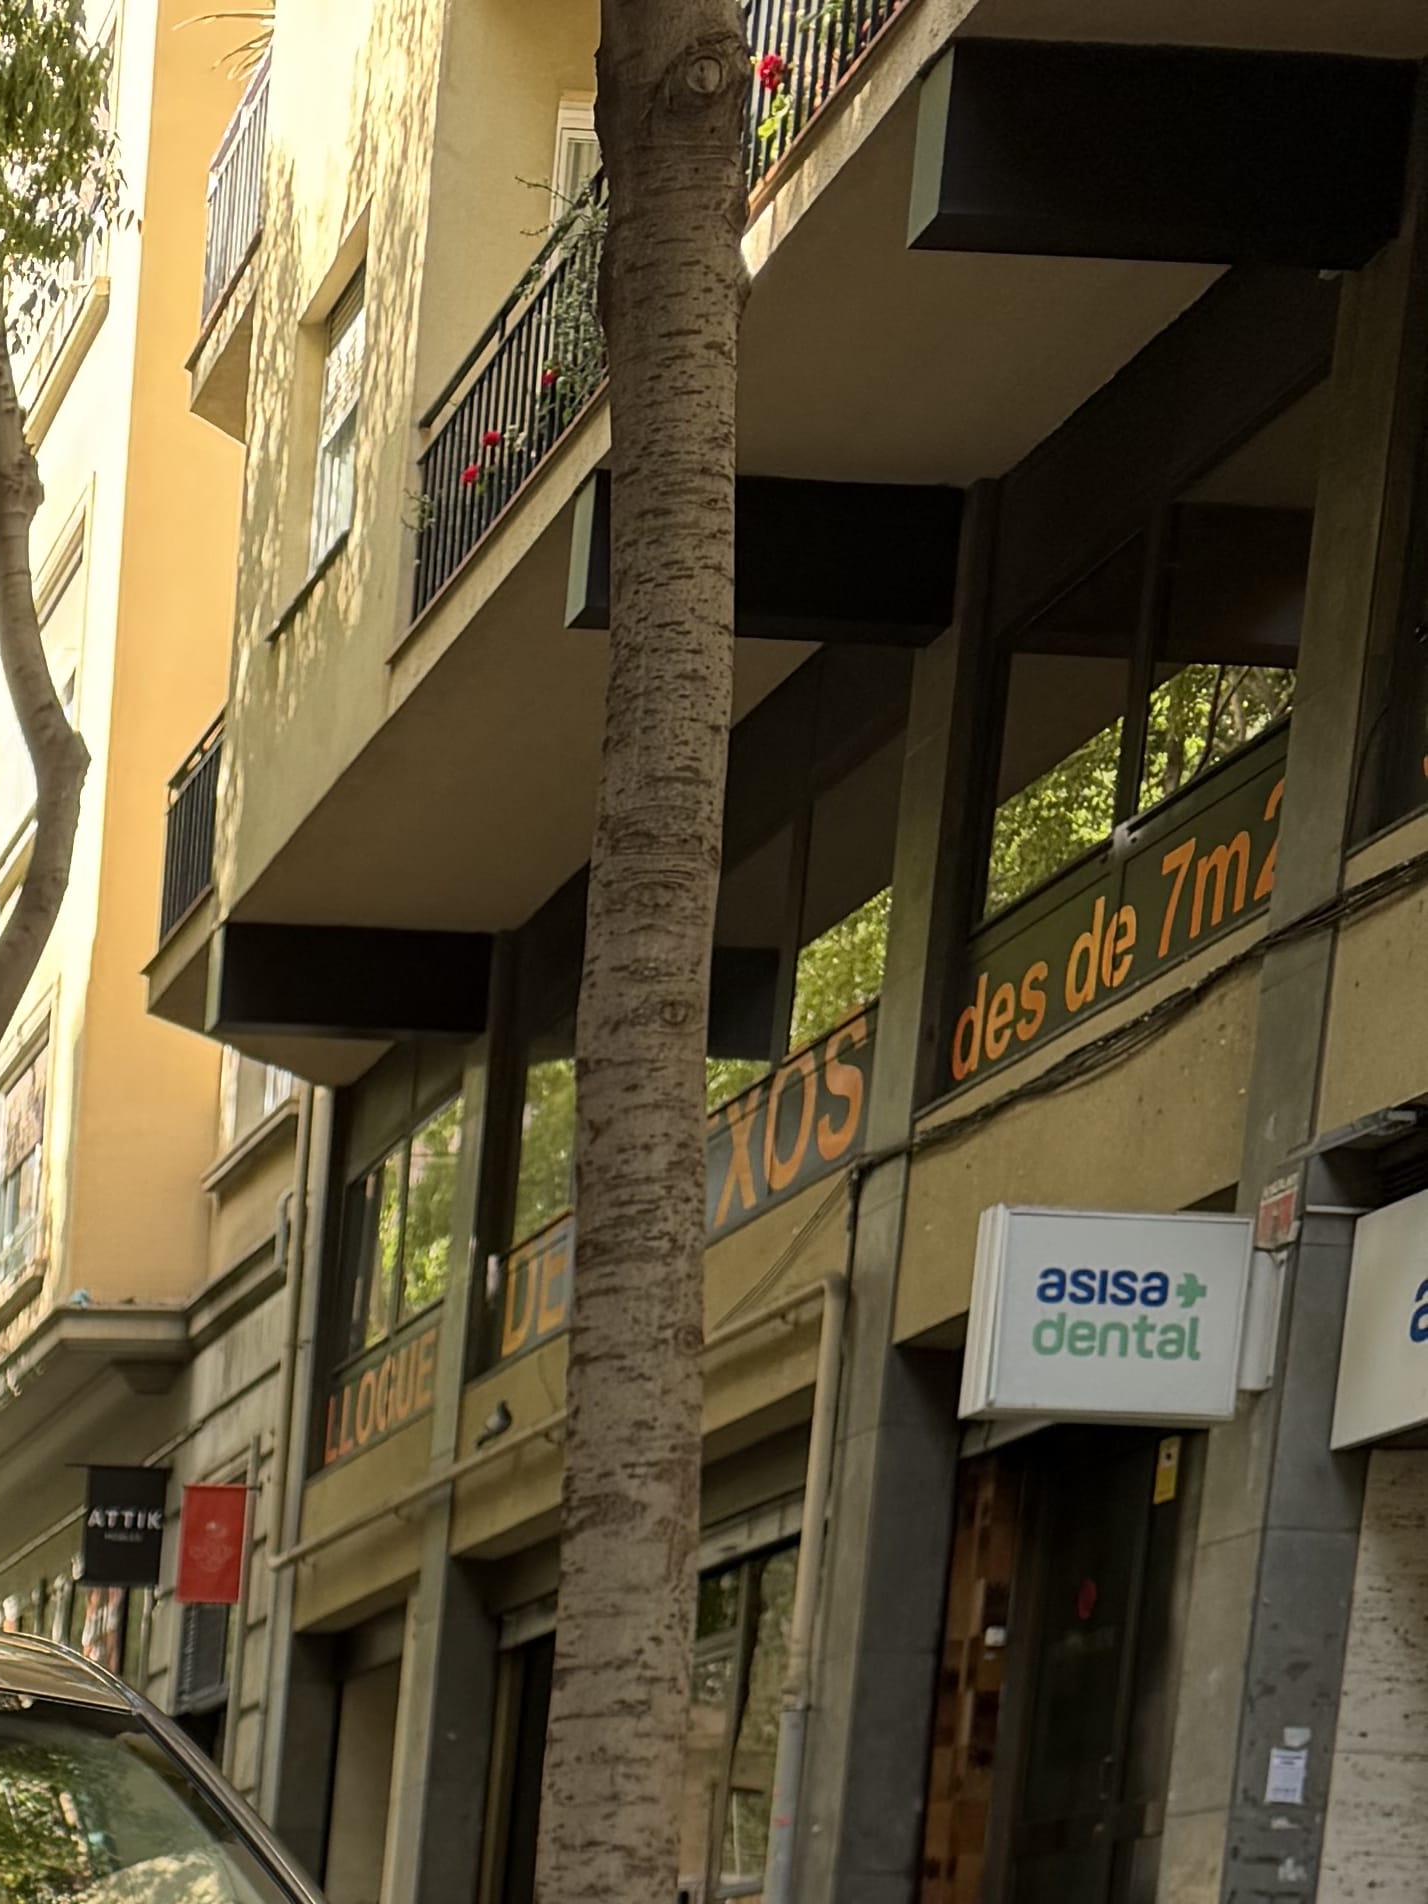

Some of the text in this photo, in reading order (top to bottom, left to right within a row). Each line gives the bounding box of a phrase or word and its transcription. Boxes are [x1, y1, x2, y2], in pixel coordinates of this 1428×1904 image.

[325, 1327, 437, 1464] LLOGUE
[951, 972, 1049, 1081] des
[1065, 896, 1137, 1012] de
[1032, 1313, 1201, 1361] dental
[87, 1506, 162, 1530] ATTIK
